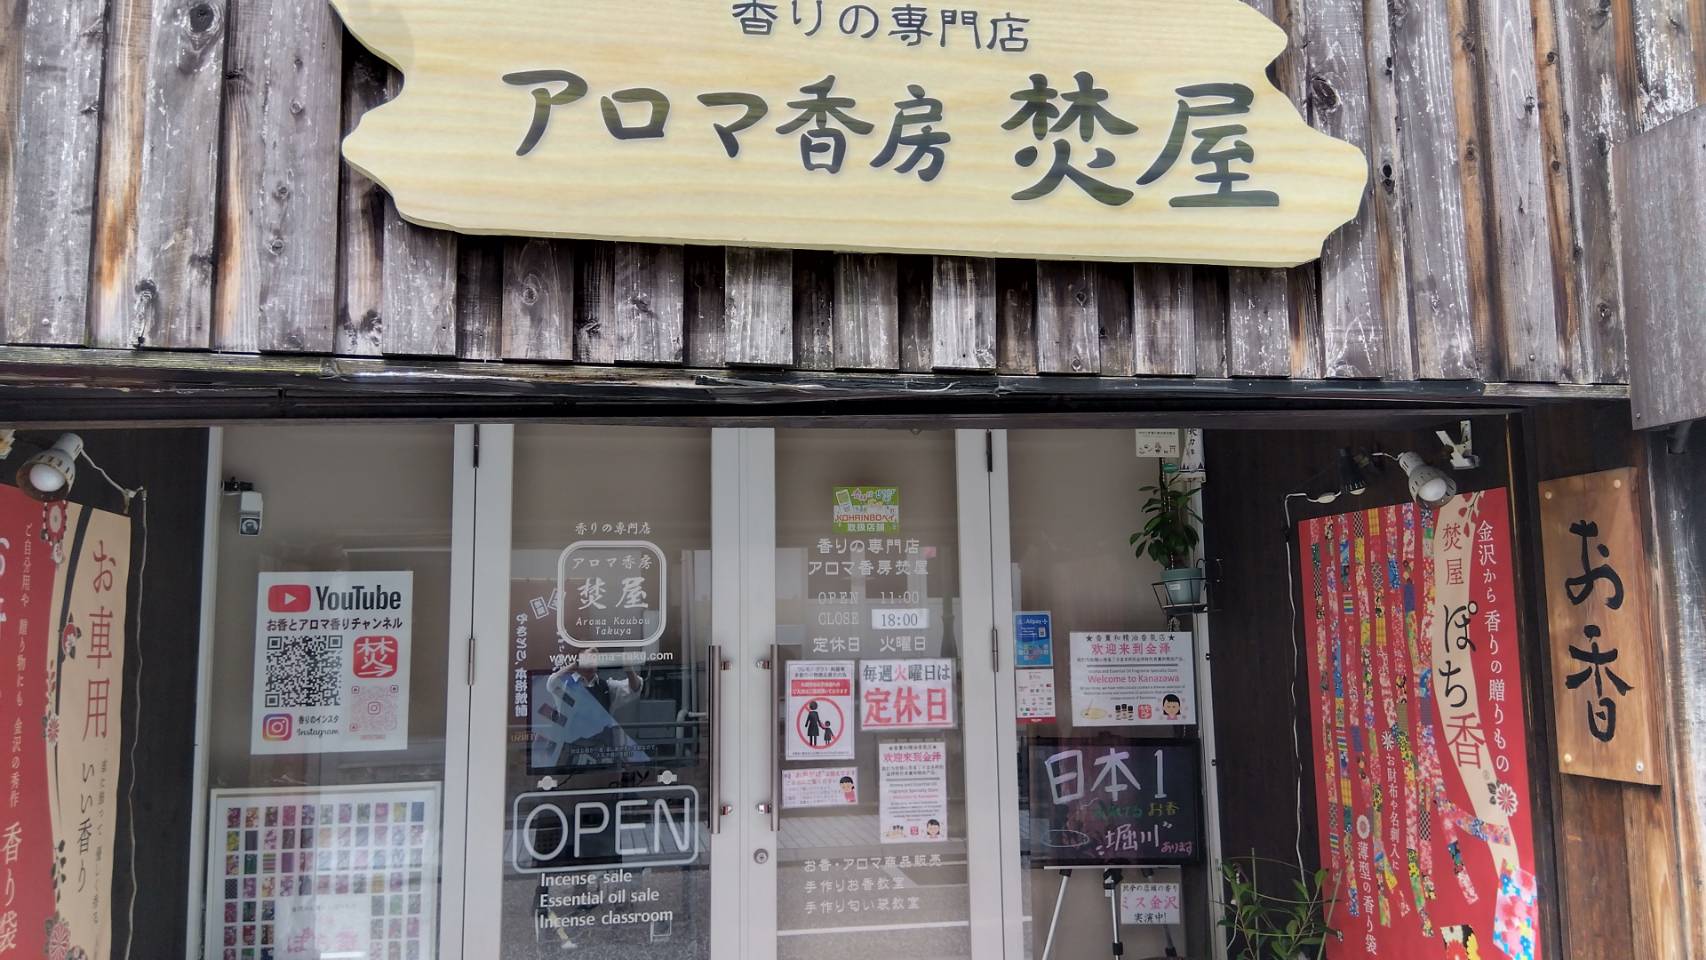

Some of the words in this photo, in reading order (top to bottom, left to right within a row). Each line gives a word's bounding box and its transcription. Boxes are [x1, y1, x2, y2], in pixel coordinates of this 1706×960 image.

[731, 0, 1031, 52] 香りの専門店
[502, 69, 951, 182] アロマ香房
[1000, 71, 1280, 208] 焚屋
[575, 522, 651, 536] 香りの専門店
[817, 538, 920, 554] 香りの専門店
[1442, 522, 1465, 586] 焚屋
[572, 554, 653, 569] アロマ香房
[808, 560, 929, 576] アロマ香房焚屋
[315, 585, 402, 611] YouTube
[577, 576, 649, 611] 焚屋
[818, 591, 859, 604] OPEN
[880, 591, 919, 604] 11:00
[266, 617, 403, 632] お香とアロマ香りチャンネル
[576, 617, 607, 626] Aroma
[613, 616, 651, 625] Koubou
[818, 612, 859, 625] CLOSE
[881, 613, 918, 626] 18:00
[596, 627, 632, 636] Takuya
[1565, 519, 1634, 743] お香
[81, 540, 117, 742] お車用
[813, 637, 861, 652] 定休日
[880, 636, 926, 652] 火曜日
[863, 664, 951, 682] 毎週火曜日は
[1087, 675, 1126, 684] Welcome
[1128, 675, 1137, 683] to
[1138, 674, 1180, 683] Kanazawa
[1438, 601, 1485, 770] ぽち香
[864, 687, 947, 724] 定休日
[298, 715, 339, 725] 香りのインスタ
[297, 728, 339, 739] Instagram
[77, 762, 95, 893] いい香り
[523, 797, 690, 861] OPEN
[804, 854, 943, 873] お香・アロマ商品販売
[540, 872, 597, 887] Incense
[602, 868, 633, 883] sale
[804, 877, 905, 893] 手作りお香教室
[540, 891, 604, 907] Essential
[608, 889, 626, 904] oil
[630, 887, 660, 902] sale
[804, 897, 920, 914] 手作り匂い袋教室
[1121, 895, 1179, 910] ミス金沢
[539, 914, 596, 929] Incense
[601, 910, 673, 926] classroom
